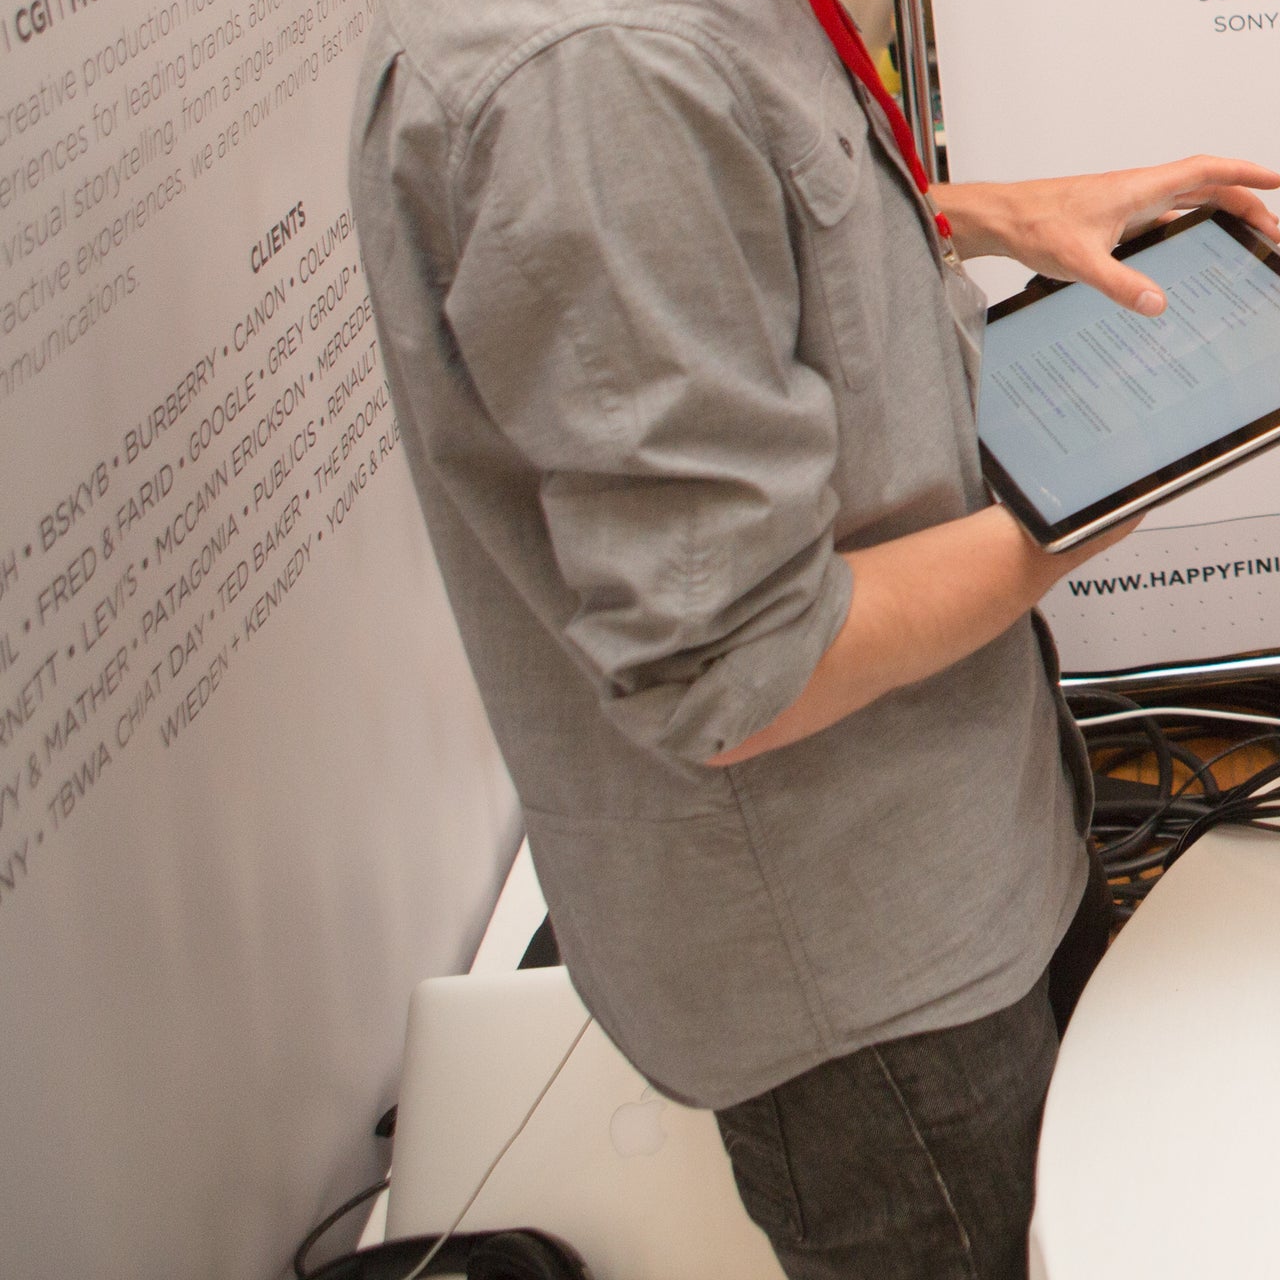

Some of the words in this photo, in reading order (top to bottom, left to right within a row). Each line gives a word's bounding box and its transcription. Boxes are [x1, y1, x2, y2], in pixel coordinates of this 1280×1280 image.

[1213, 11, 1279, 33] SONY
[251, 200, 307, 274] CLIENTS
[36, 542, 98, 628] FRED
[114, 461, 175, 543] FARID
[187, 381, 258, 465] GOOGLE
[267, 316, 304, 376] GREY
[308, 266, 351, 332] GROUP
[39, 461, 111, 554] BSKYB
[123, 347, 219, 465] BURBERRY
[233, 278, 287, 353] CANON
[45, 647, 130, 755] MATHER
[141, 512, 241, 644] PATAGONIA
[252, 426, 318, 513] PUBLICIS
[326, 341, 378, 425] RENAULT
[81, 558, 138, 654] LEVI'S
[155, 471, 229, 567] MCCANN
[232, 387, 307, 478] ERICKSON
[46, 743, 114, 830] TBWA
[115, 663, 163, 751] CHIAT
[169, 620, 207, 680] DAY
[216, 563, 249, 614] TED
[252, 493, 304, 574] BAKER
[312, 451, 341, 494] THE
[158, 646, 231, 749] WIEDEN
[243, 539, 313, 636] KENNEDY
[325, 466, 370, 535] YOUNG
